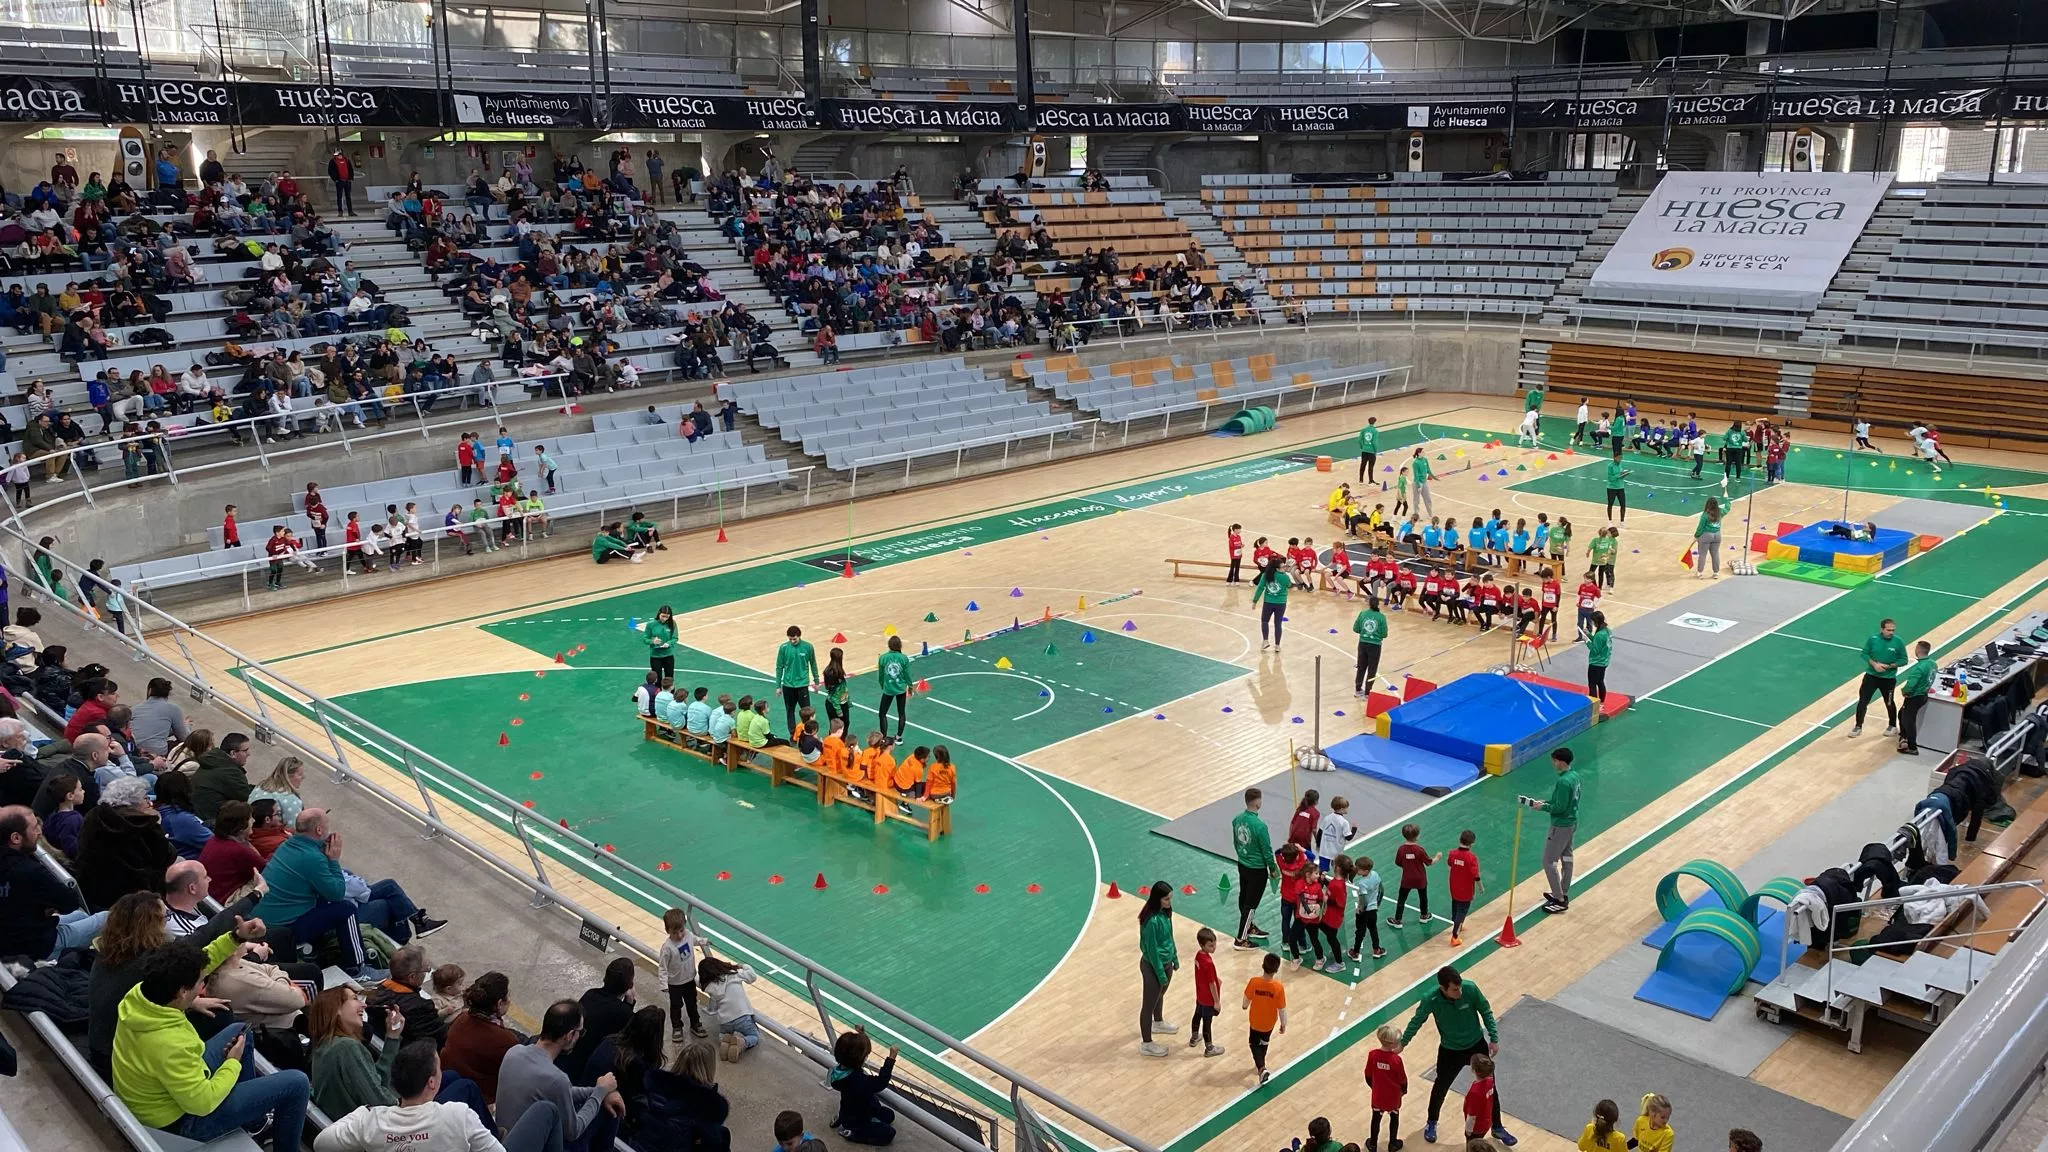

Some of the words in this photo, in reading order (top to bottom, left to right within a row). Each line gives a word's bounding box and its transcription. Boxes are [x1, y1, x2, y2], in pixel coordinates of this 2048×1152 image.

[485, 97, 570, 112] Ayuntamiento
[747, 99, 806, 117] Huesc
[1434, 105, 1506, 117] Ayuntamiento
[489, 112, 503, 124] de
[507, 112, 554, 125] Huesca
[1036, 110, 1090, 126] uesca
[1433, 117, 1446, 127] de
[1449, 117, 1488, 127] Huesca
[1699, 260, 1782, 270] HUESCA
[1007, 504, 1105, 527] Hacemos
[1114, 485, 1188, 503] deporte
[852, 526, 983, 556] Ayuntamiento
[895, 536, 975, 555] Huesca
[386, 1134, 406, 1143] See
[409, 1132, 429, 1144] you
